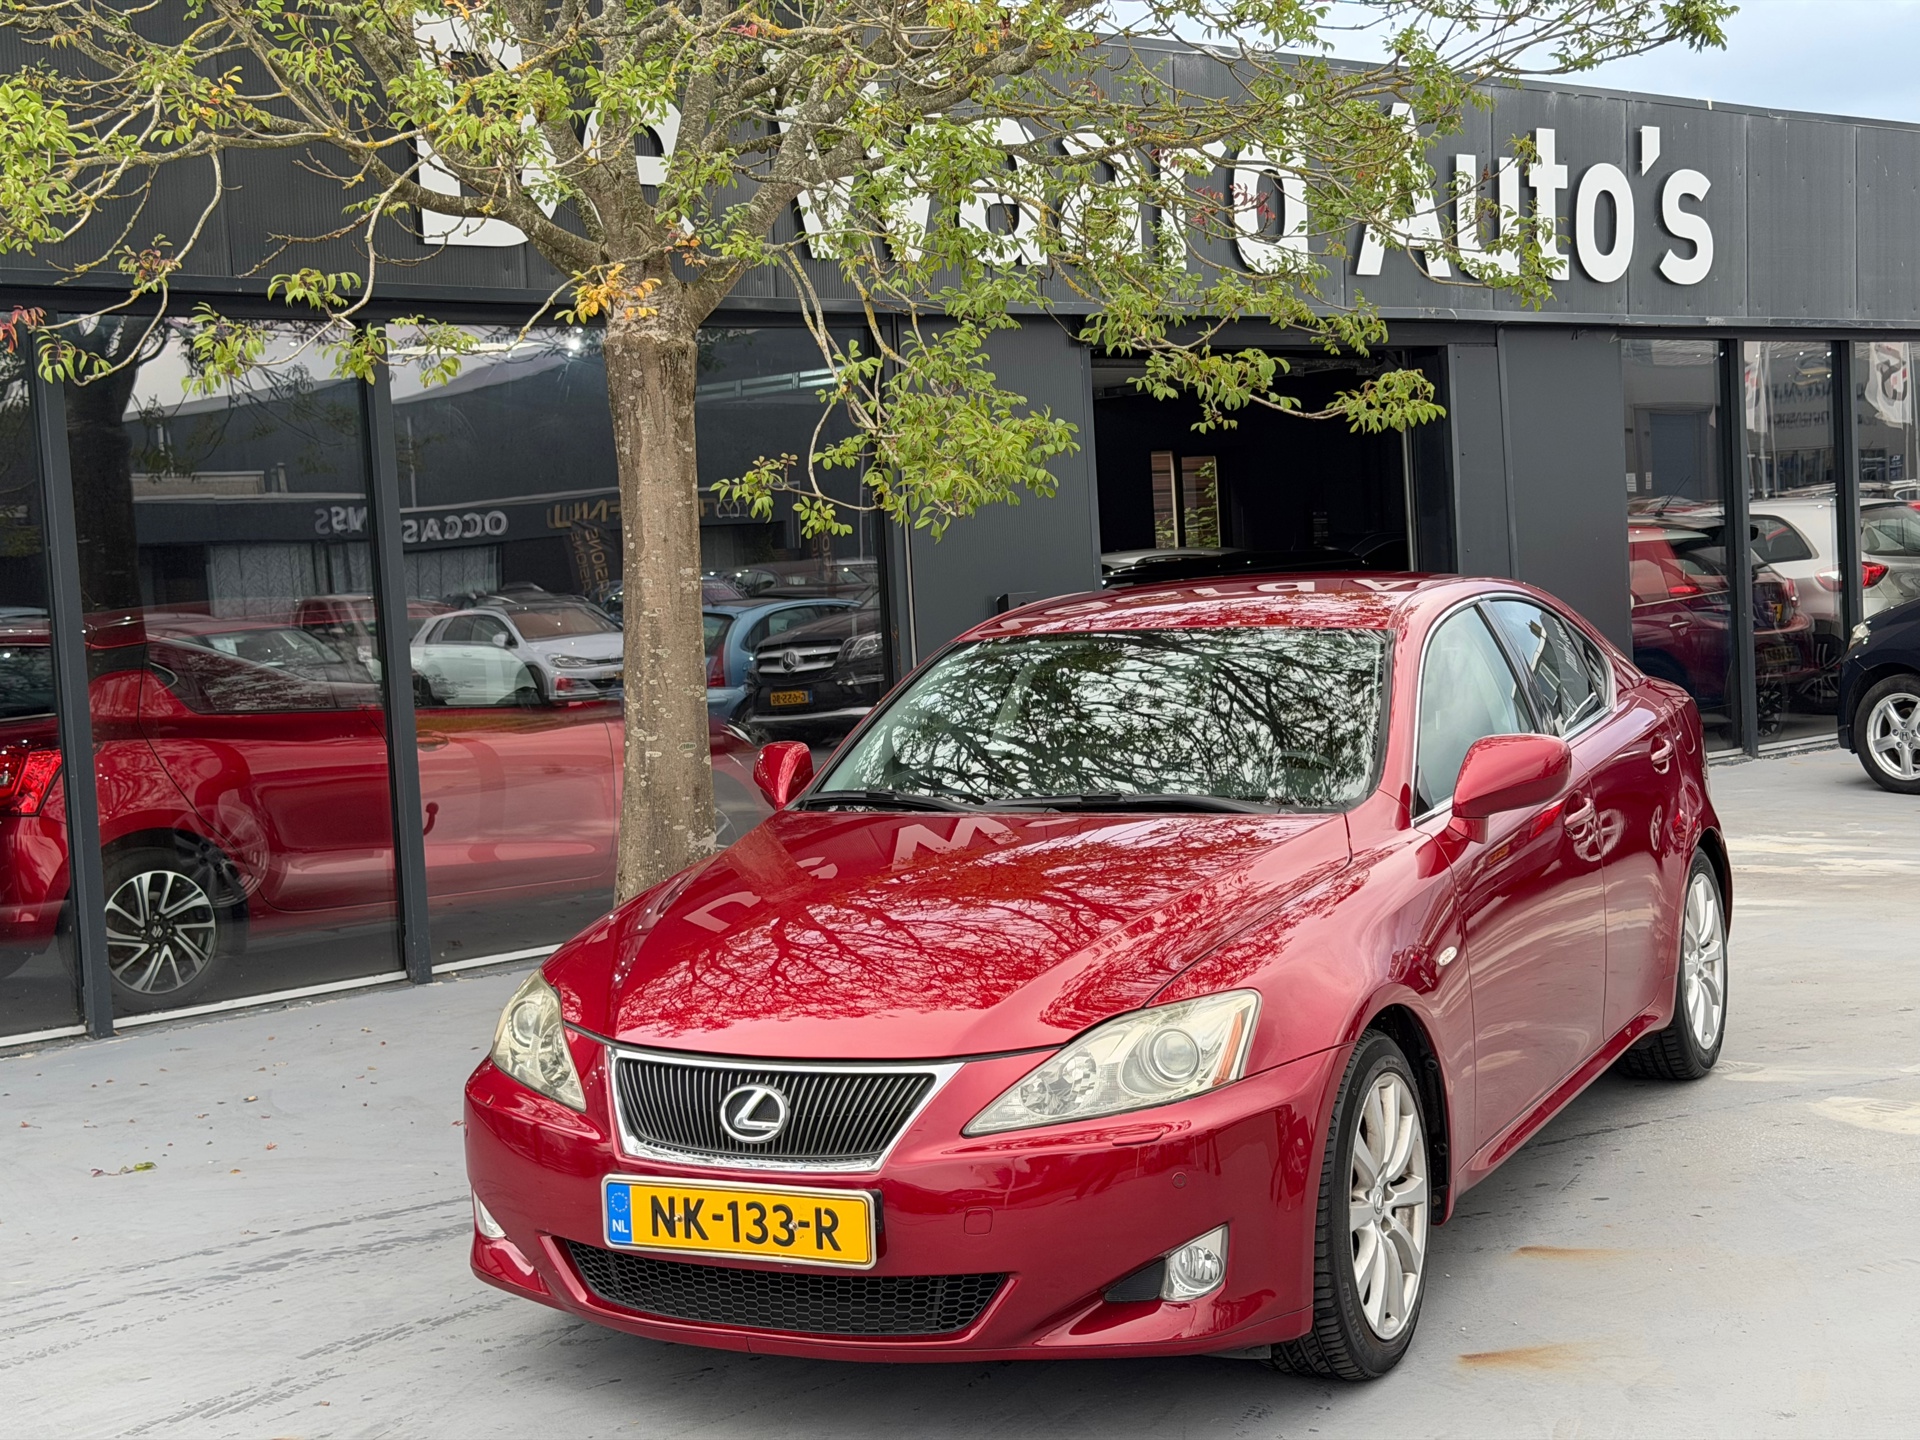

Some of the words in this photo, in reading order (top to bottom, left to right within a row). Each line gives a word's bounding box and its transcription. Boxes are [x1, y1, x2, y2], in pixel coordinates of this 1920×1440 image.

[1355, 101, 1714, 286] Auto's
[611, 1218, 630, 1234] NL
[650, 1195, 842, 1252] NK-133-R
